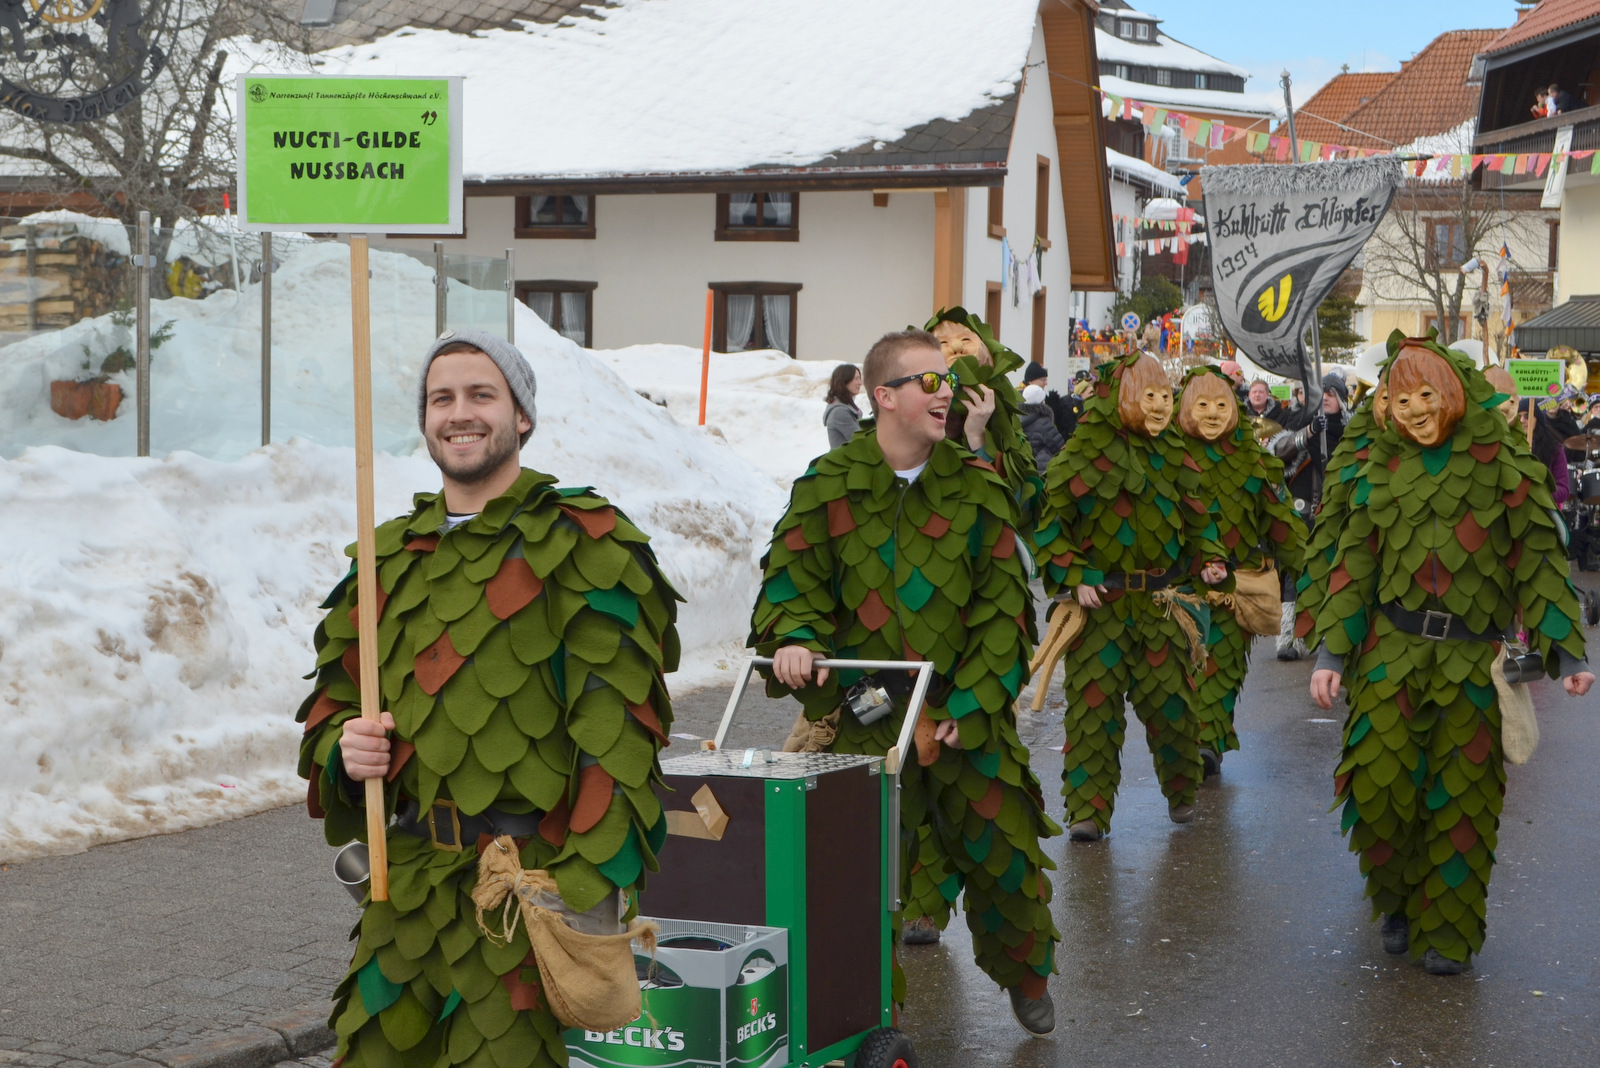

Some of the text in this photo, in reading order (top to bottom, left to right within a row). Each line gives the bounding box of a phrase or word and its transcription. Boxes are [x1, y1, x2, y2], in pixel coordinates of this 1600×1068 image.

[269, 92, 314, 101] Narrenzunft
[315, 92, 366, 101] Tannenzäpfle
[368, 91, 427, 101] Höchenschwand
[421, 110, 438, 126] 19
[273, 131, 421, 149] NUCTI-GILDE
[290, 162, 405, 180] NUSSBACH
[1216, 242, 1259, 282] 1994
[736, 1011, 777, 1044] BECK'S
[584, 1026, 685, 1052] BECK'S
